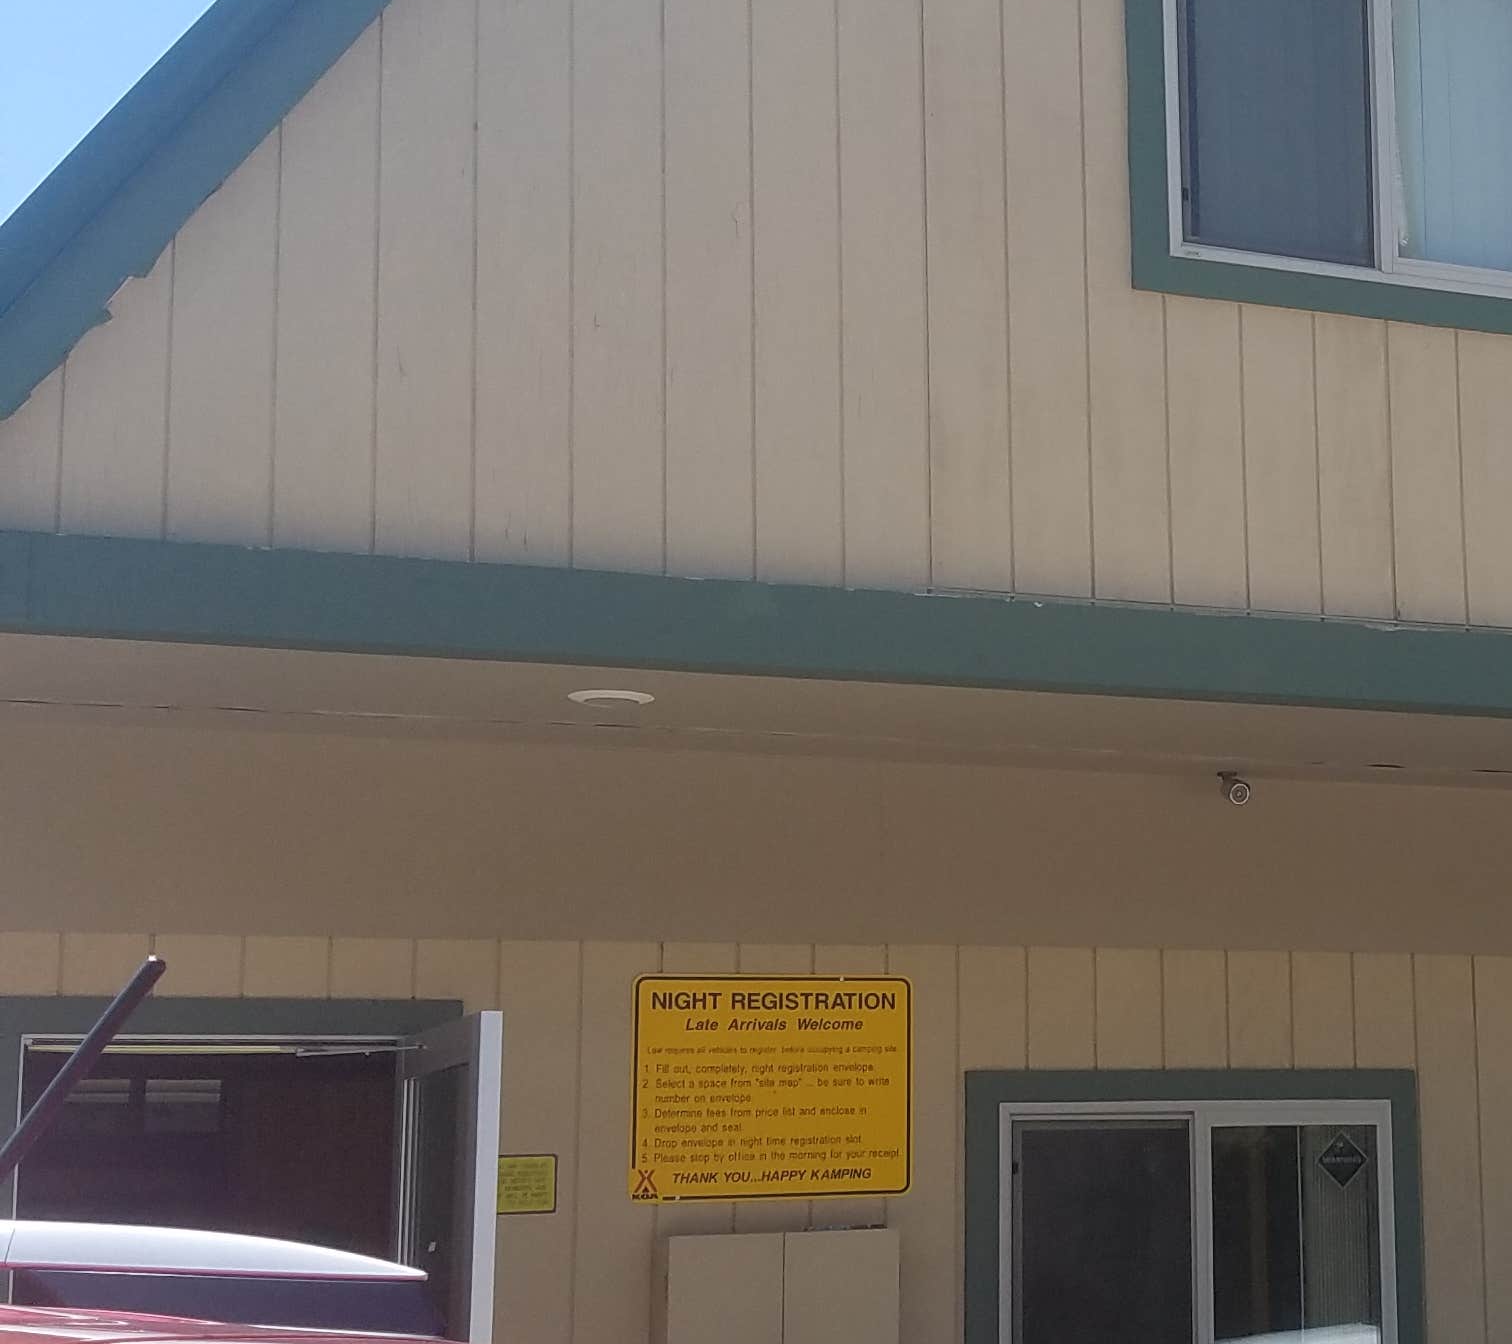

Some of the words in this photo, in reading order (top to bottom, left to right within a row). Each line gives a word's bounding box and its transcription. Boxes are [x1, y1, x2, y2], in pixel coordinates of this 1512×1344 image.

[652, 992, 722, 1010] NIGHT
[732, 993, 895, 1010] REGISTRATION
[686, 1018, 718, 1030] Late
[728, 1019, 786, 1030] Arrivals
[798, 1018, 863, 1030] Welcome
[696, 1064, 747, 1075] completely,
[751, 1064, 774, 1075] night
[778, 1063, 829, 1075] registration
[833, 1063, 873, 1073] envelope
[656, 1078, 685, 1088] Select
[698, 1080, 727, 1090] space
[730, 1078, 751, 1088] from
[817, 1078, 829, 1087] be
[832, 1079, 852, 1087] sure
[868, 1077, 890, 1087] write
[656, 1094, 690, 1103] number
[694, 1094, 706, 1103] on
[710, 1093, 752, 1104] envelope
[655, 1108, 702, 1118] Determine
[706, 1107, 726, 1119] fees
[730, 1107, 751, 1117] from
[755, 1107, 779, 1119] price
[782, 1106, 795, 1116] list
[799, 1106, 816, 1116] and
[820, 1105, 856, 1115] enclose
[655, 1123, 697, 1134] envelope
[701, 1123, 718, 1133] and
[655, 1138, 678, 1148] Drop
[681, 1137, 723, 1149] envelope
[740, 1136, 762, 1148] night
[766, 1136, 786, 1146] time
[790, 1135, 841, 1147] registration
[654, 1153, 686, 1163] Please
[690, 1153, 710, 1164] stop
[714, 1153, 724, 1164] by
[728, 1152, 755, 1162] office
[771, 1151, 785, 1161] the
[789, 1151, 826, 1161] morning
[830, 1149, 843, 1159] for
[846, 1150, 866, 1161] your
[673, 1173, 718, 1184] THANK
[724, 1170, 806, 1182] YOU...HAPPY
[810, 1168, 871, 1180] KAMPING
